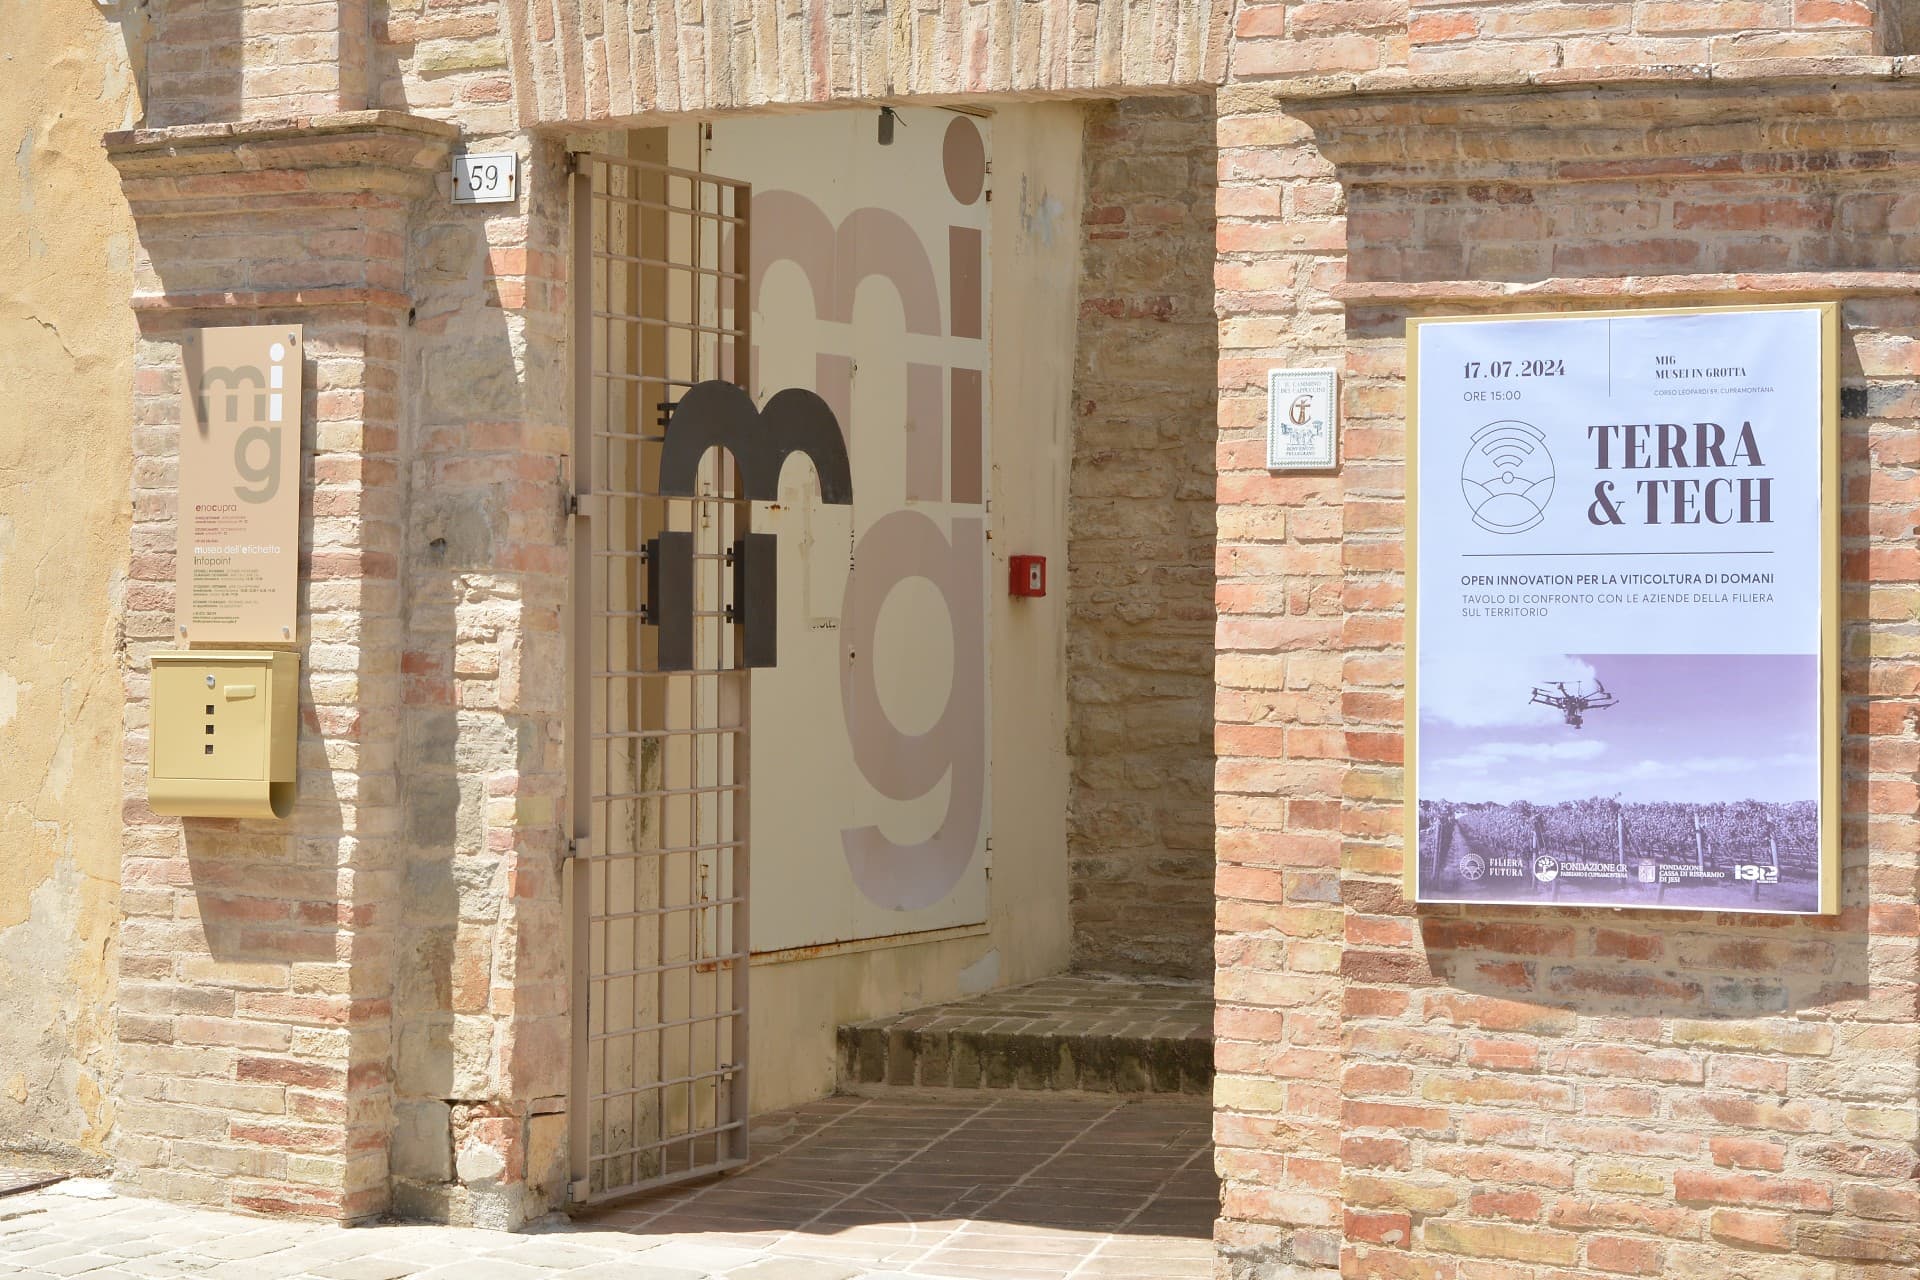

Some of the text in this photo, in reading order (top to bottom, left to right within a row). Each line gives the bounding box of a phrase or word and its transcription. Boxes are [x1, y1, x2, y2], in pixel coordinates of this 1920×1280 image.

[469, 165, 498, 191] 59
[1655, 355, 1676, 366] MIG
[1464, 359, 1567, 379] 17.07.2024
[1655, 366, 1747, 379] MUSEI IN GROTTA
[1463, 390, 1522, 401] ORE 15:00
[1588, 421, 1766, 470] TERRA
[1588, 478, 1775, 526] & TECH
[195, 504, 238, 514] enocupra
[193, 556, 232, 567] Infopoint
[1461, 573, 1774, 586] OPEN INNOVATION PER LA VITICOLTURA DI DOMANI
[1462, 593, 1774, 604] TAVOLO DI CONFRONTO CON LE AZIENDE DELLA FILIERA
[1462, 608, 1549, 617] SUL TERRITORIO
[1489, 858, 1523, 868] FILIERA
[1560, 862, 1628, 872] FONDAZIONE CR
[1659, 864, 1704, 872] FONDAZIONE
[1489, 869, 1523, 878] FUTURA
